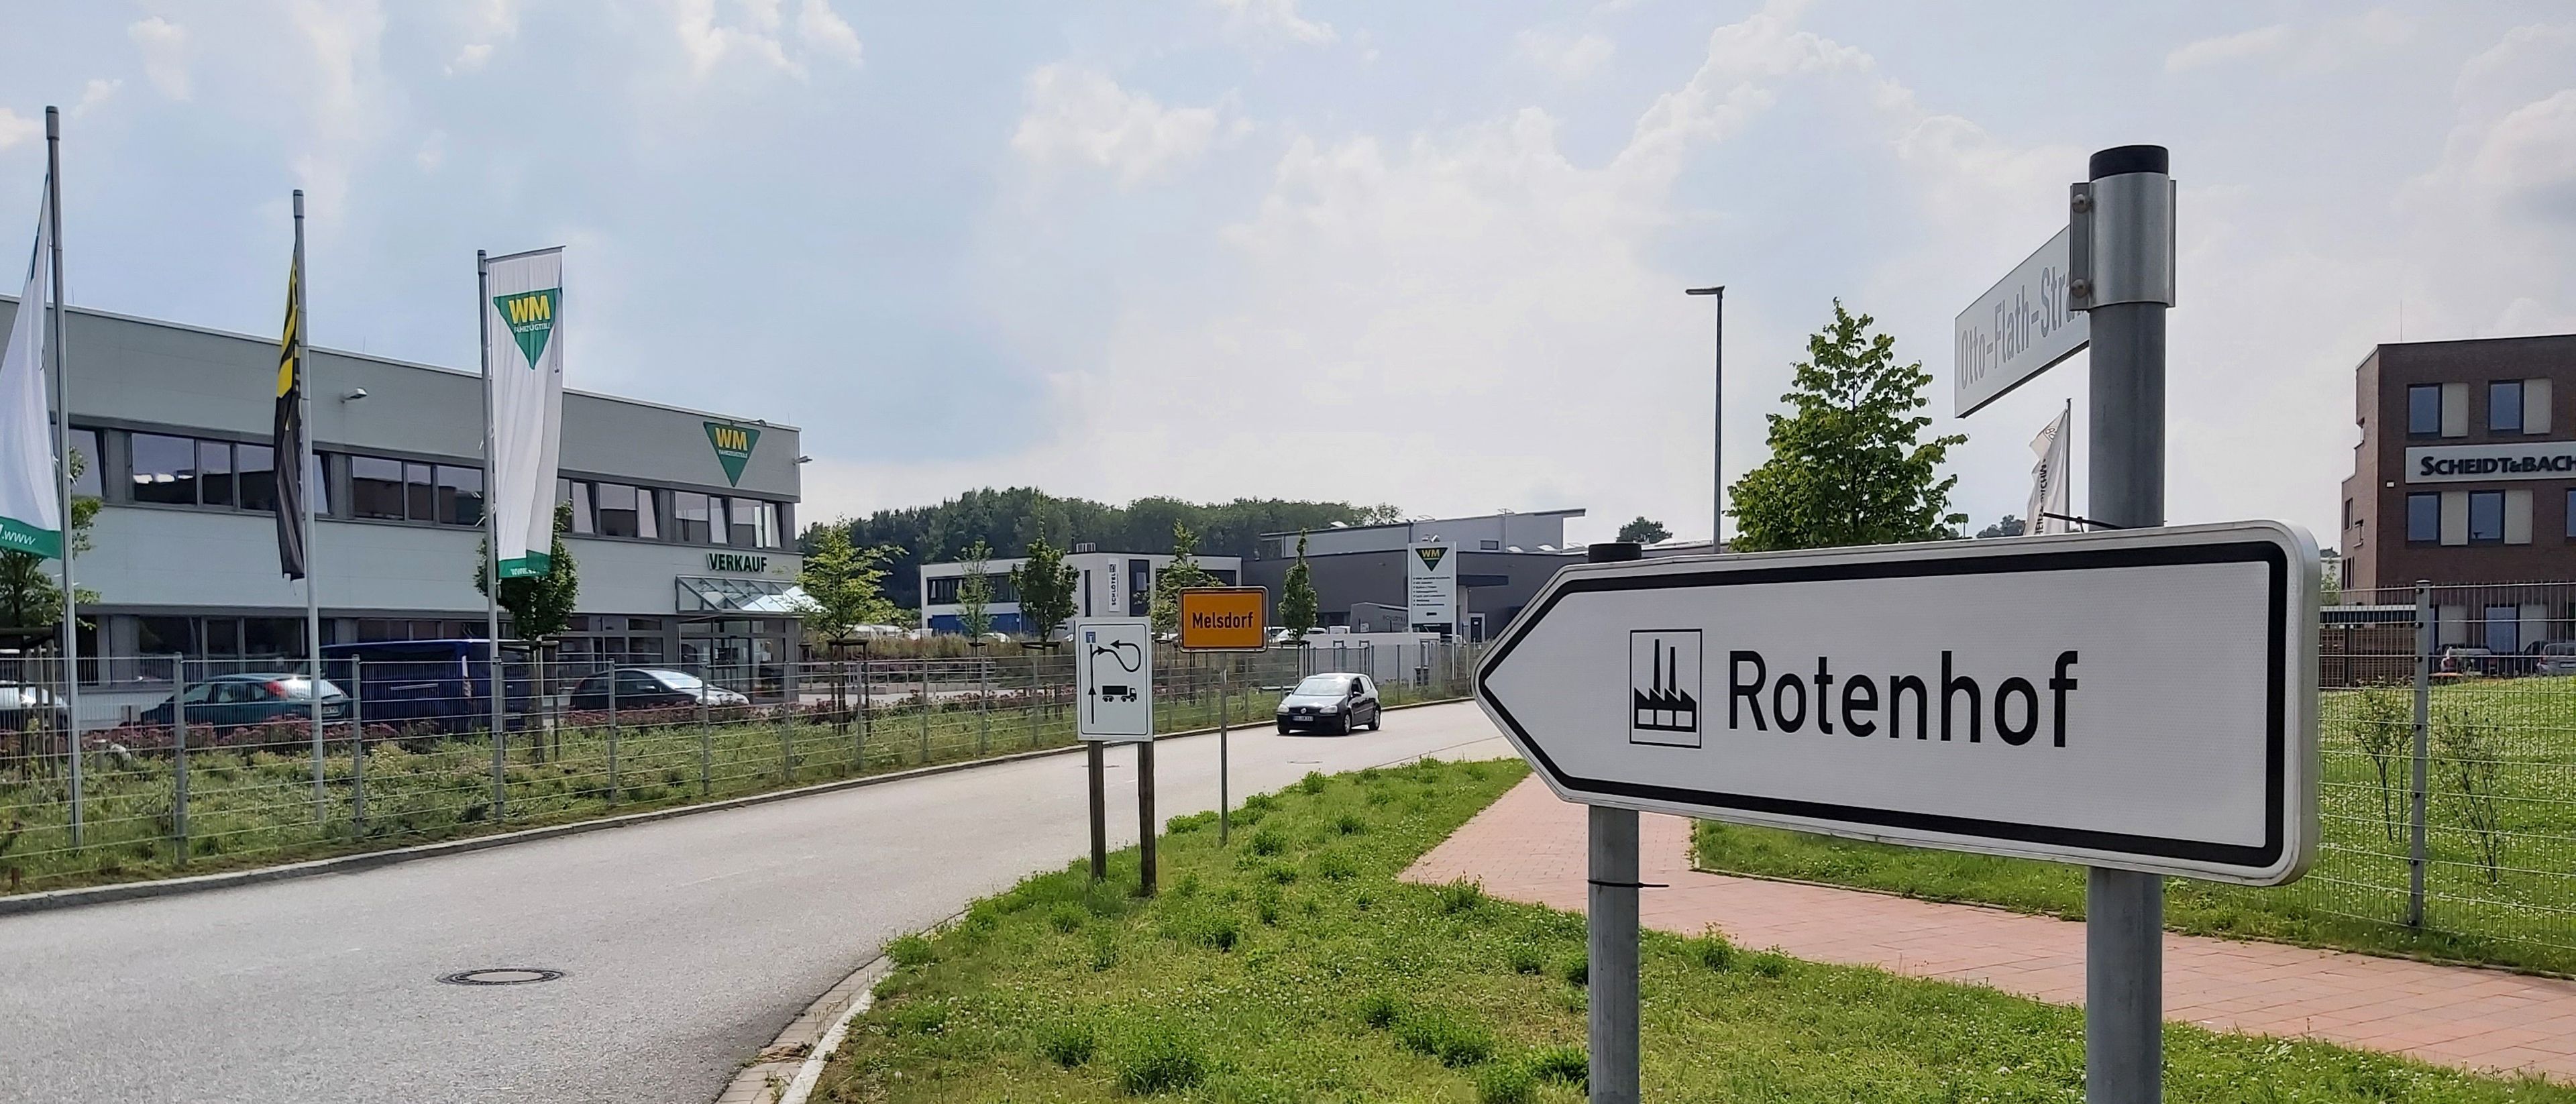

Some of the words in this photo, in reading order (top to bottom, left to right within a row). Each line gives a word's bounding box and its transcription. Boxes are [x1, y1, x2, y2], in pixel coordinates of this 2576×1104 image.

[508, 295, 550, 324] WM
[1961, 266, 2086, 389] Otto-Flath-Stra
[715, 427, 748, 451] WM
[708, 553, 767, 572] VERKAUF
[1421, 549, 1440, 557] WM
[1193, 612, 1253, 628] Melsdorf
[1729, 651, 2078, 747] Rotenhof
